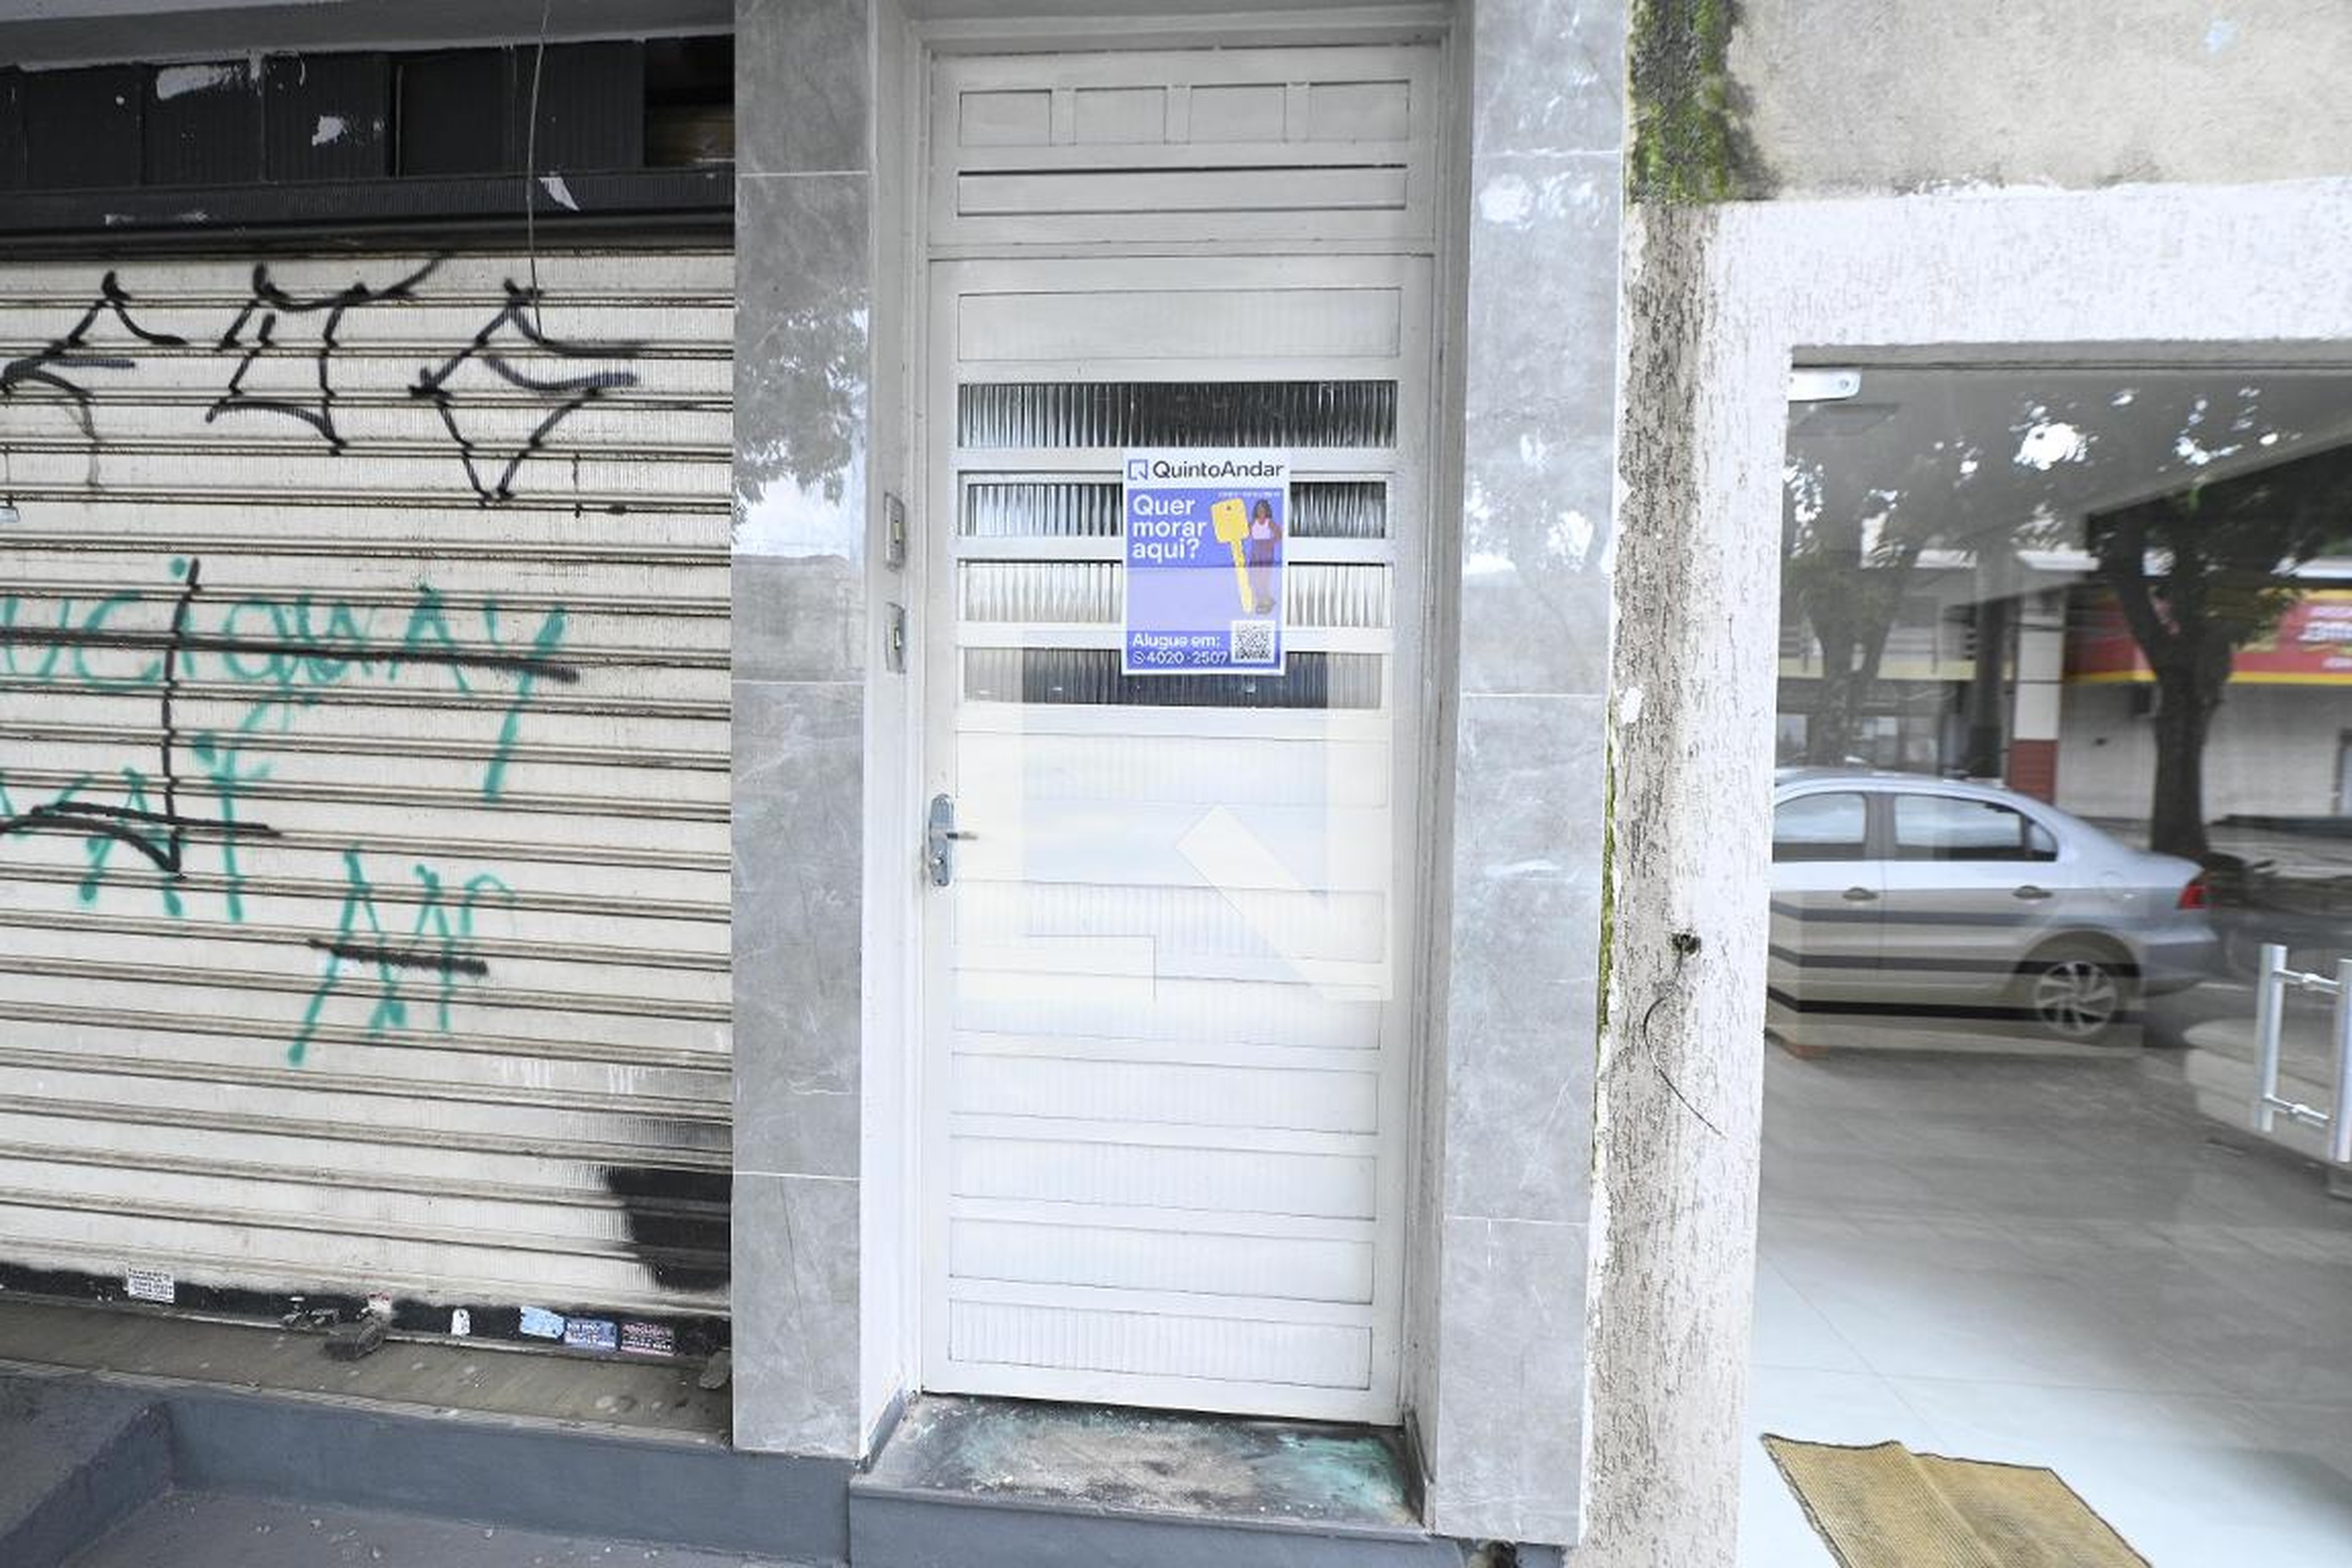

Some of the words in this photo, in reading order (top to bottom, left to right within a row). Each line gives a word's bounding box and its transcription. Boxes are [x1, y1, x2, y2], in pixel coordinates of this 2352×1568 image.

[1153, 461, 1284, 478] QuintoAndar
[1133, 494, 1195, 516] Quer
[1133, 521, 1206, 537] morar
[1133, 538, 1199, 563] aqui?
[1133, 633, 1187, 650] Alugue
